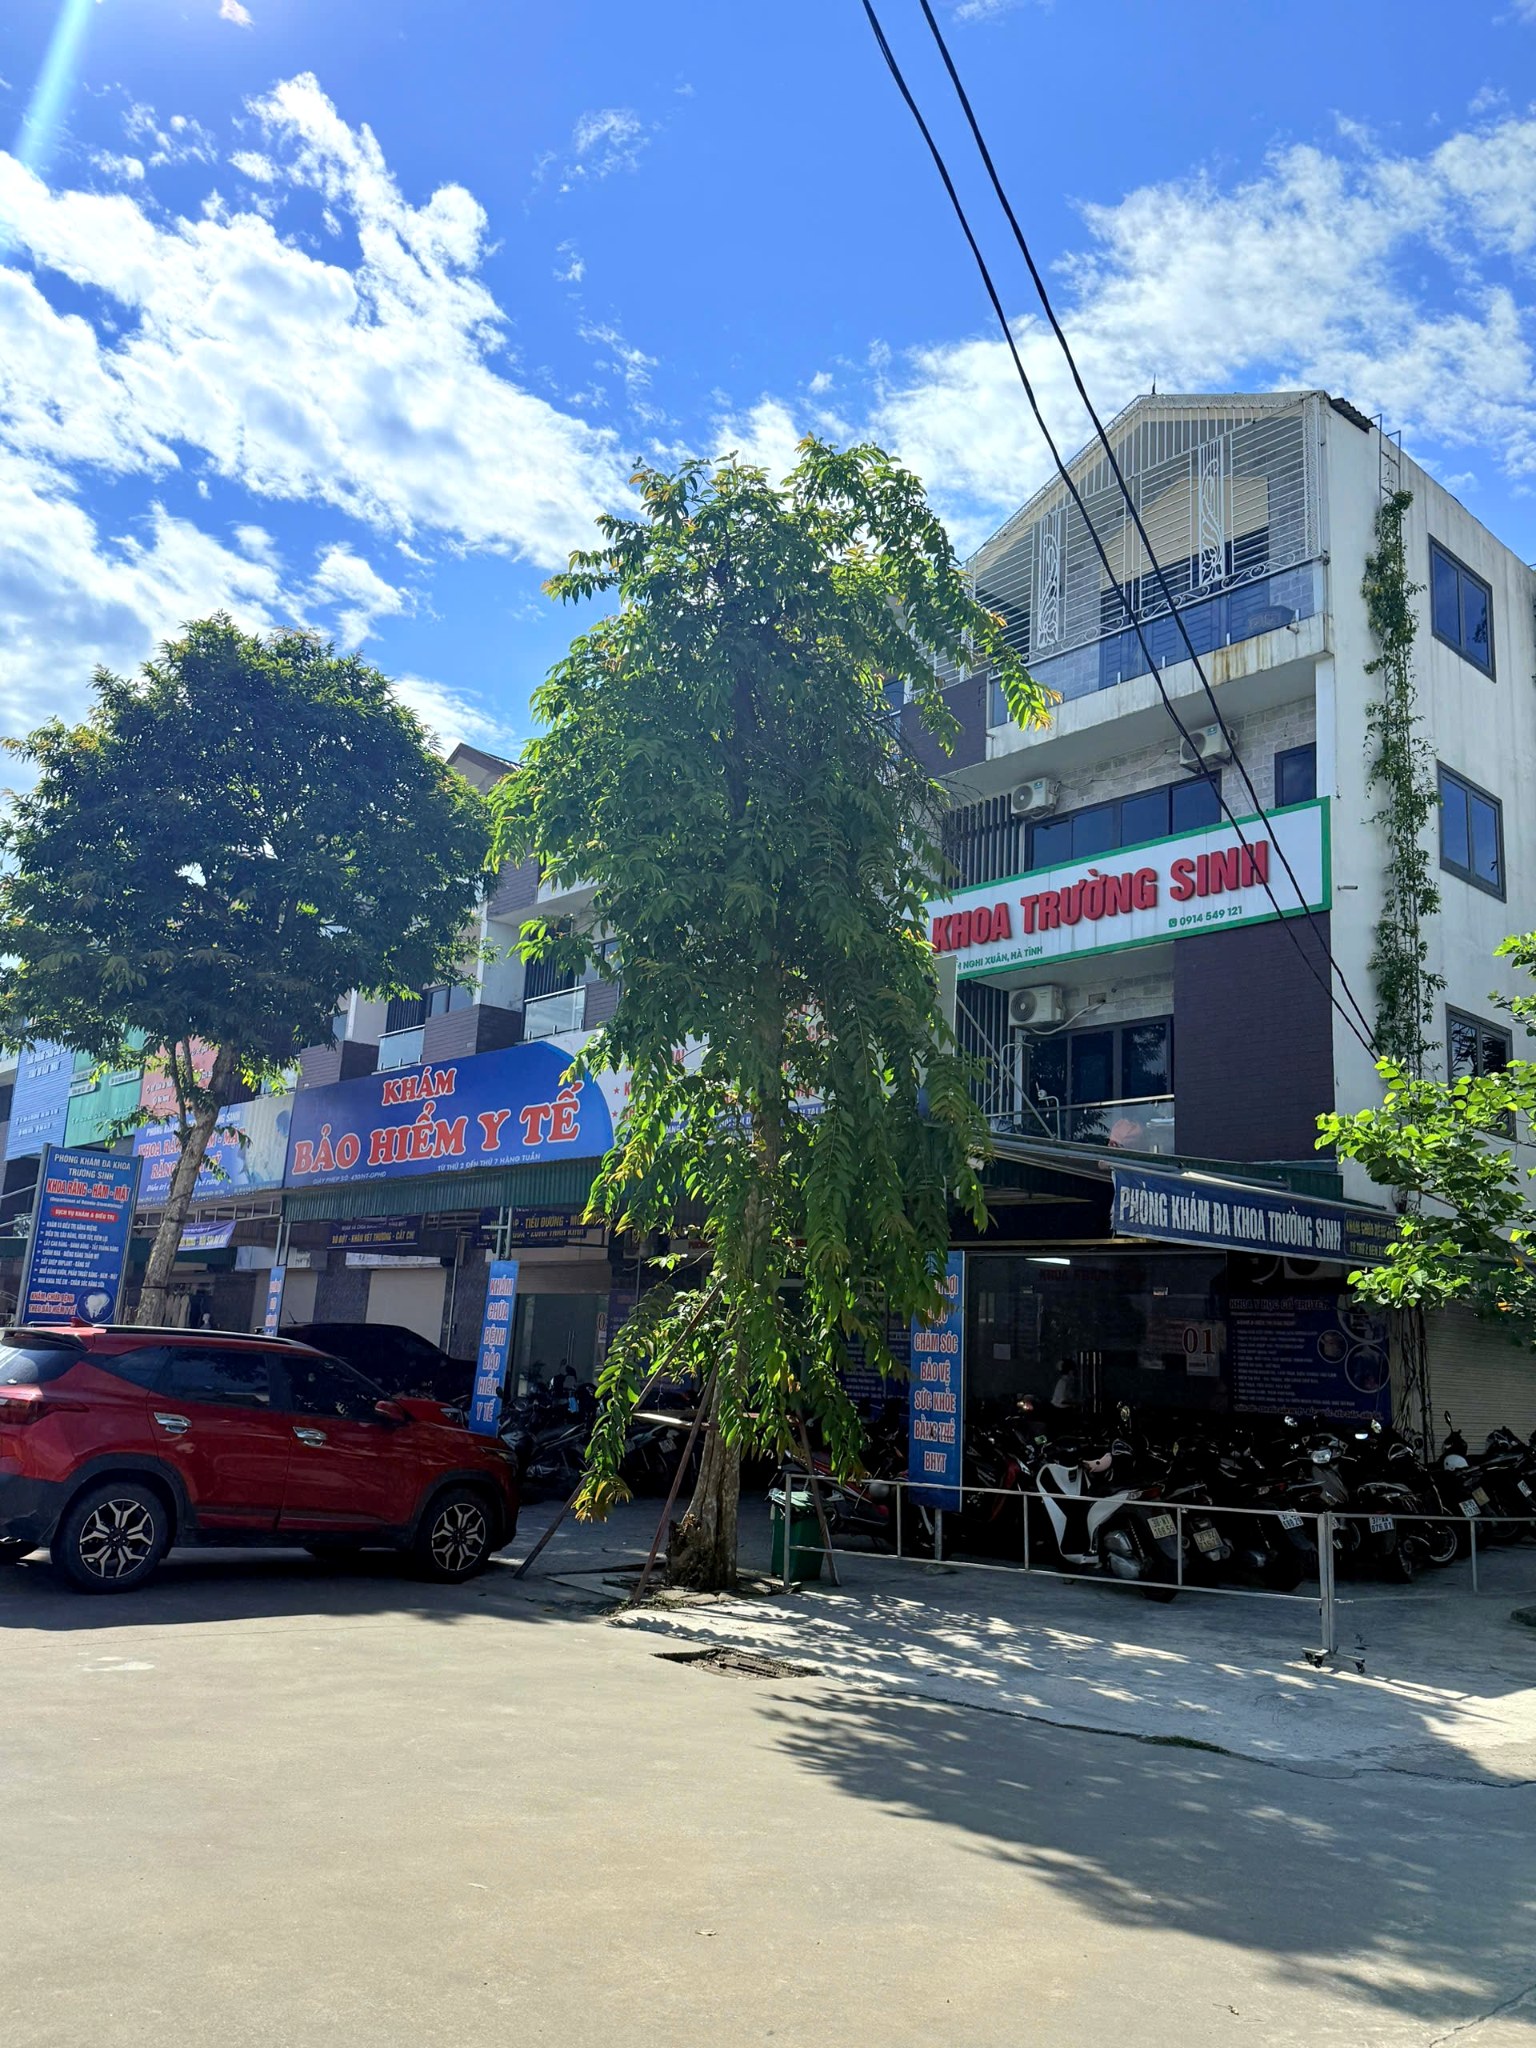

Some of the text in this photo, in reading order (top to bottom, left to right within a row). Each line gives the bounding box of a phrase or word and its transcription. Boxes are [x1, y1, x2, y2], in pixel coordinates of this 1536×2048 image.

[932, 840, 1269, 953] KHOA TRƯỜNG SINH
[1179, 905, 1242, 927] 0914 549 121
[962, 958, 983, 971] NGHI
[1010, 948, 1023, 962] HÀ
[1024, 945, 1043, 959] TĨNH
[381, 1066, 457, 1106] KHÁM
[291, 1080, 585, 1175] BẢO HIỂM Y TẾ
[97, 1171, 114, 1180] SINH
[112, 1161, 131, 1170] KHOA
[46, 1178, 66, 1194] KHOA
[66, 1178, 88, 1197] RĂNG
[1119, 1182, 1342, 1251] PHÒNG KHÁM ĐA KHOA TRƯỜNG SINH
[490, 1275, 513, 1296] KHÁM
[488, 1300, 508, 1320] CHỮA
[484, 1324, 506, 1348] BỆNH
[914, 1331, 958, 1354] CHĂM SÓC
[1183, 1327, 1216, 1354] 01
[482, 1347, 500, 1371] BẢO
[920, 1356, 938, 1382] BẢO
[938, 1360, 951, 1387] VỆ
[476, 1398, 496, 1423] Y TẾ
[914, 1388, 956, 1414] SỨC KHỎE
[914, 1414, 955, 1443] BẰNG THẺ
[924, 1450, 946, 1473] BHYT
